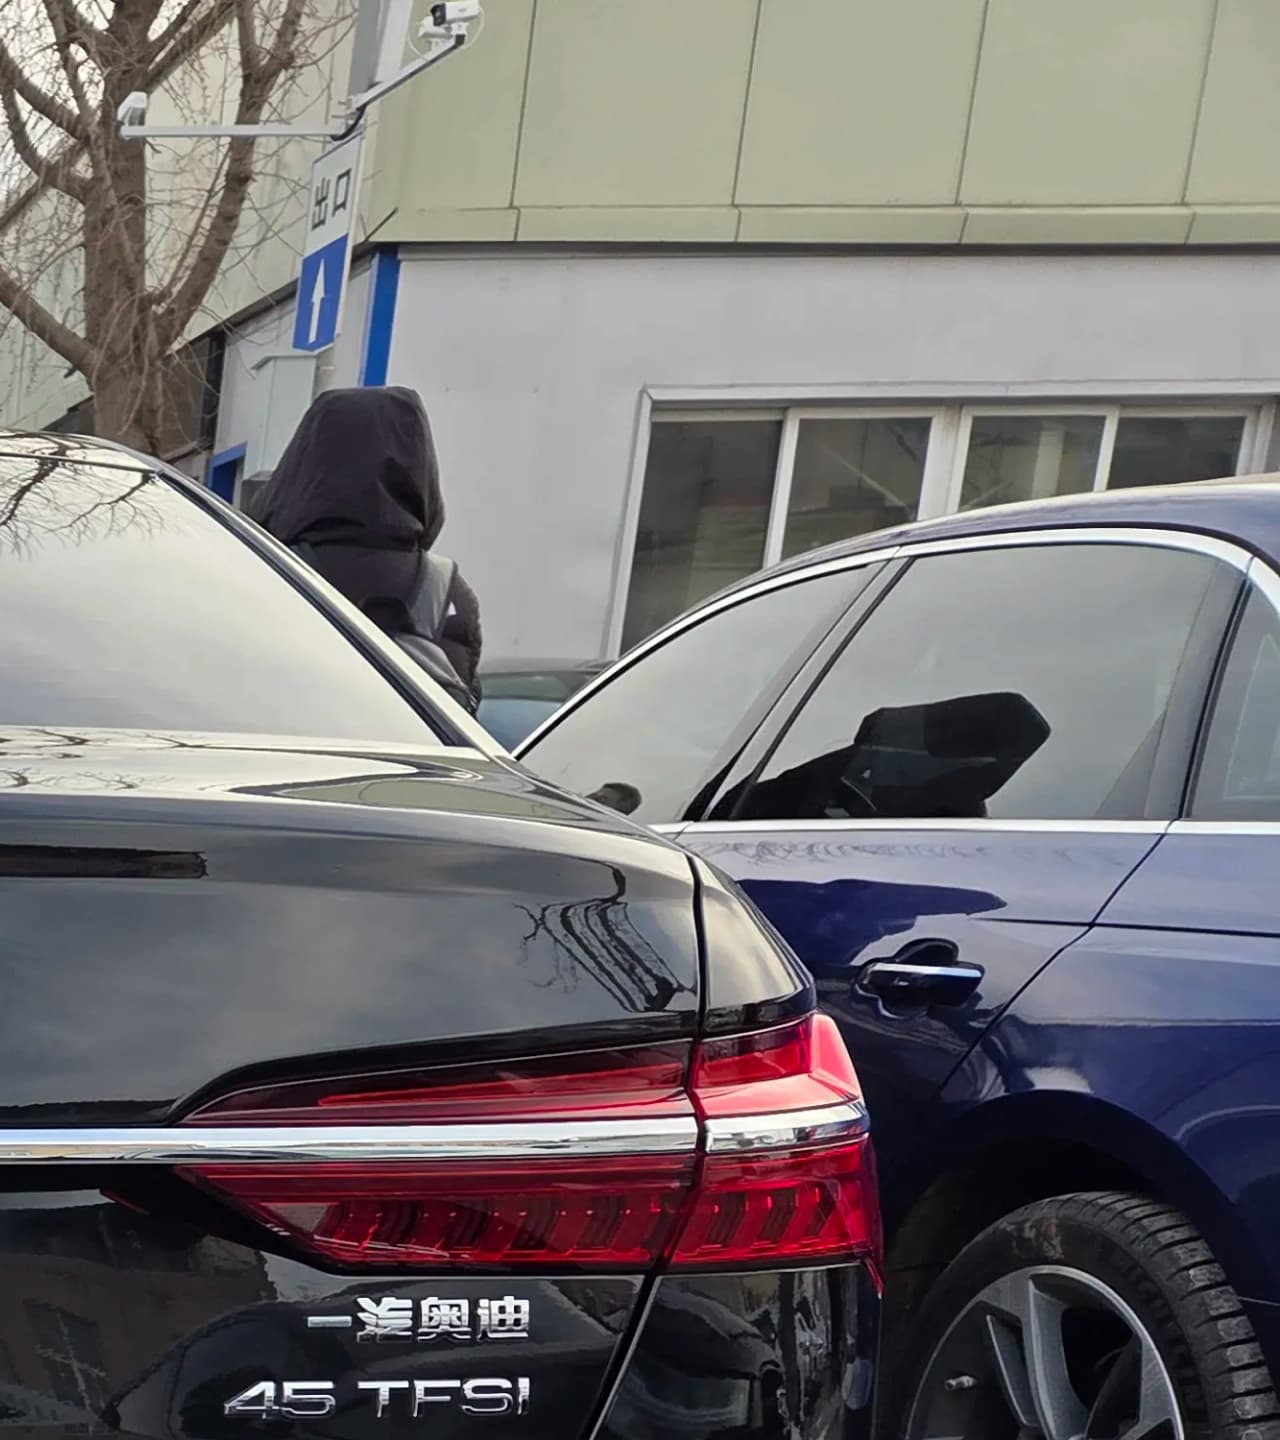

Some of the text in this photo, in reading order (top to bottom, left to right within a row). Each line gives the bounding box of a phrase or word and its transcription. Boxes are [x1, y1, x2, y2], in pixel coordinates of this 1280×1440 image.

[310, 167, 352, 231] 出口
[307, 1295, 530, 1343] 一汽奥迪
[224, 1377, 531, 1419] 45 TFSI
